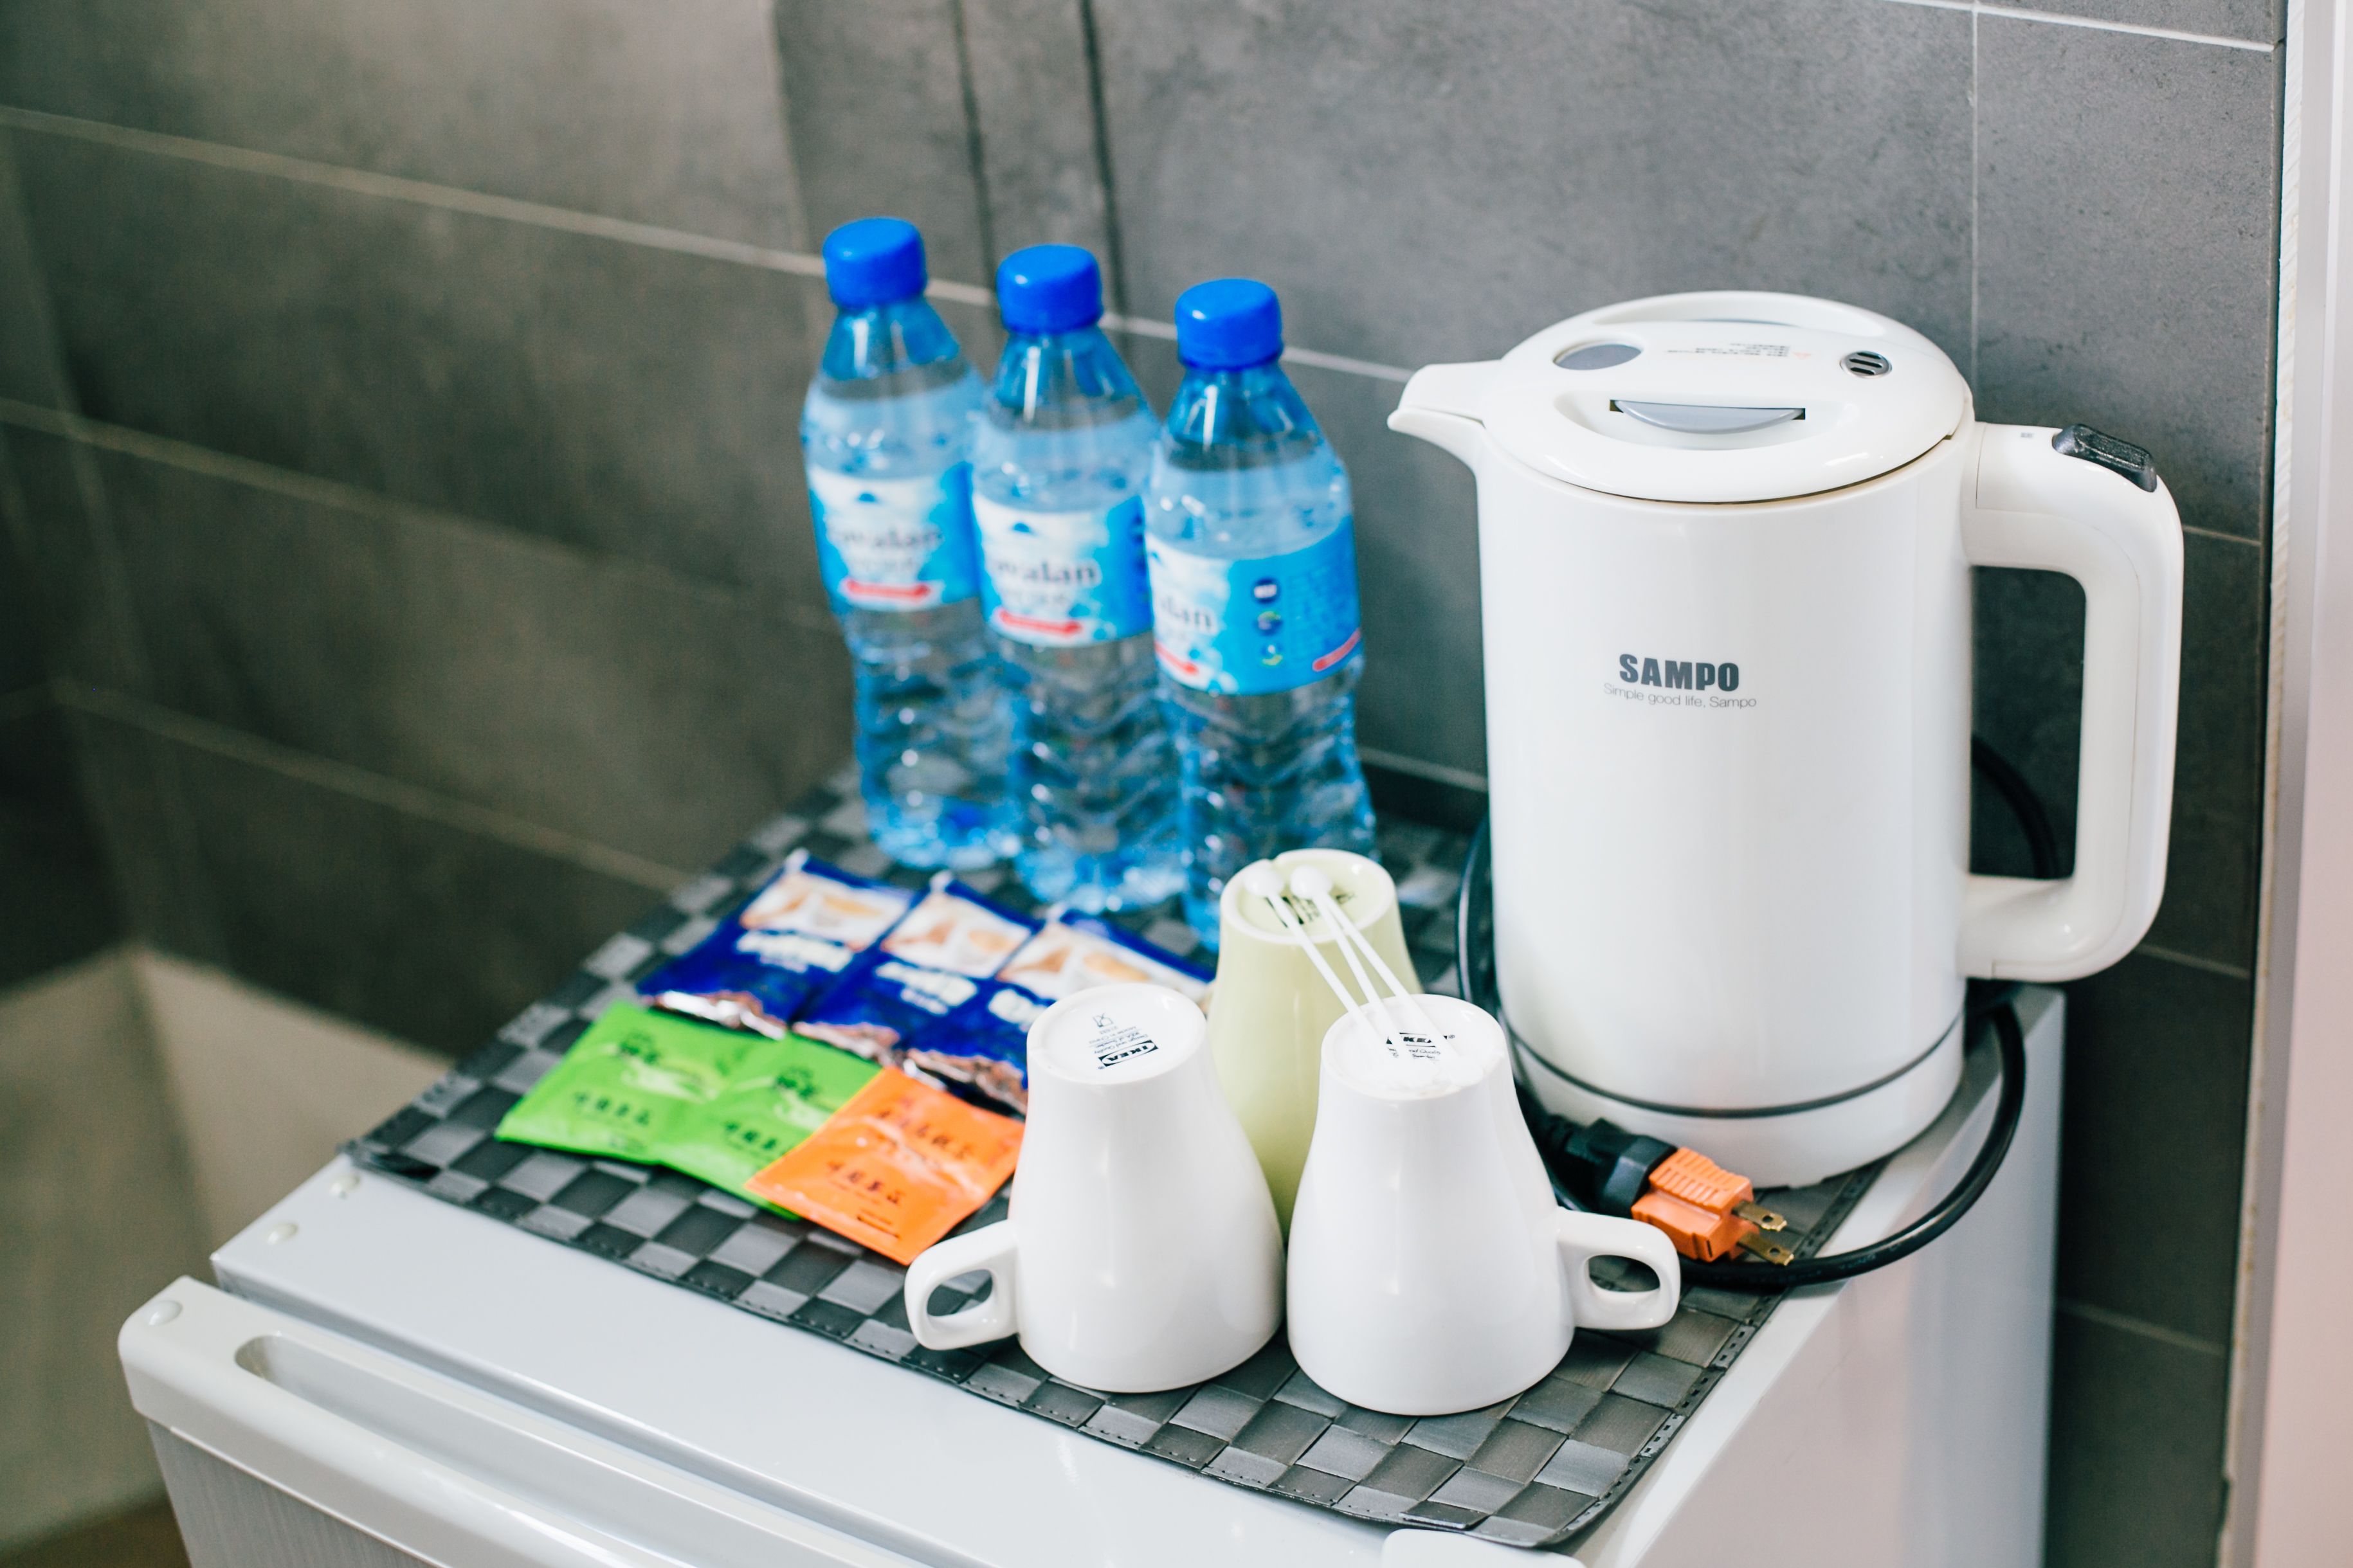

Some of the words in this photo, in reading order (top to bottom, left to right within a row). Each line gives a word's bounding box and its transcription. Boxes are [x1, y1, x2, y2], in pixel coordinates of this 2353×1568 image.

[1619, 654, 1739, 692] SAMPO
[1603, 683, 1644, 701] Simple
[1648, 694, 1681, 706] good
[1685, 696, 1706, 708] life,
[1709, 696, 1757, 710] Sampo
[1107, 1045, 1149, 1061] IKEA
